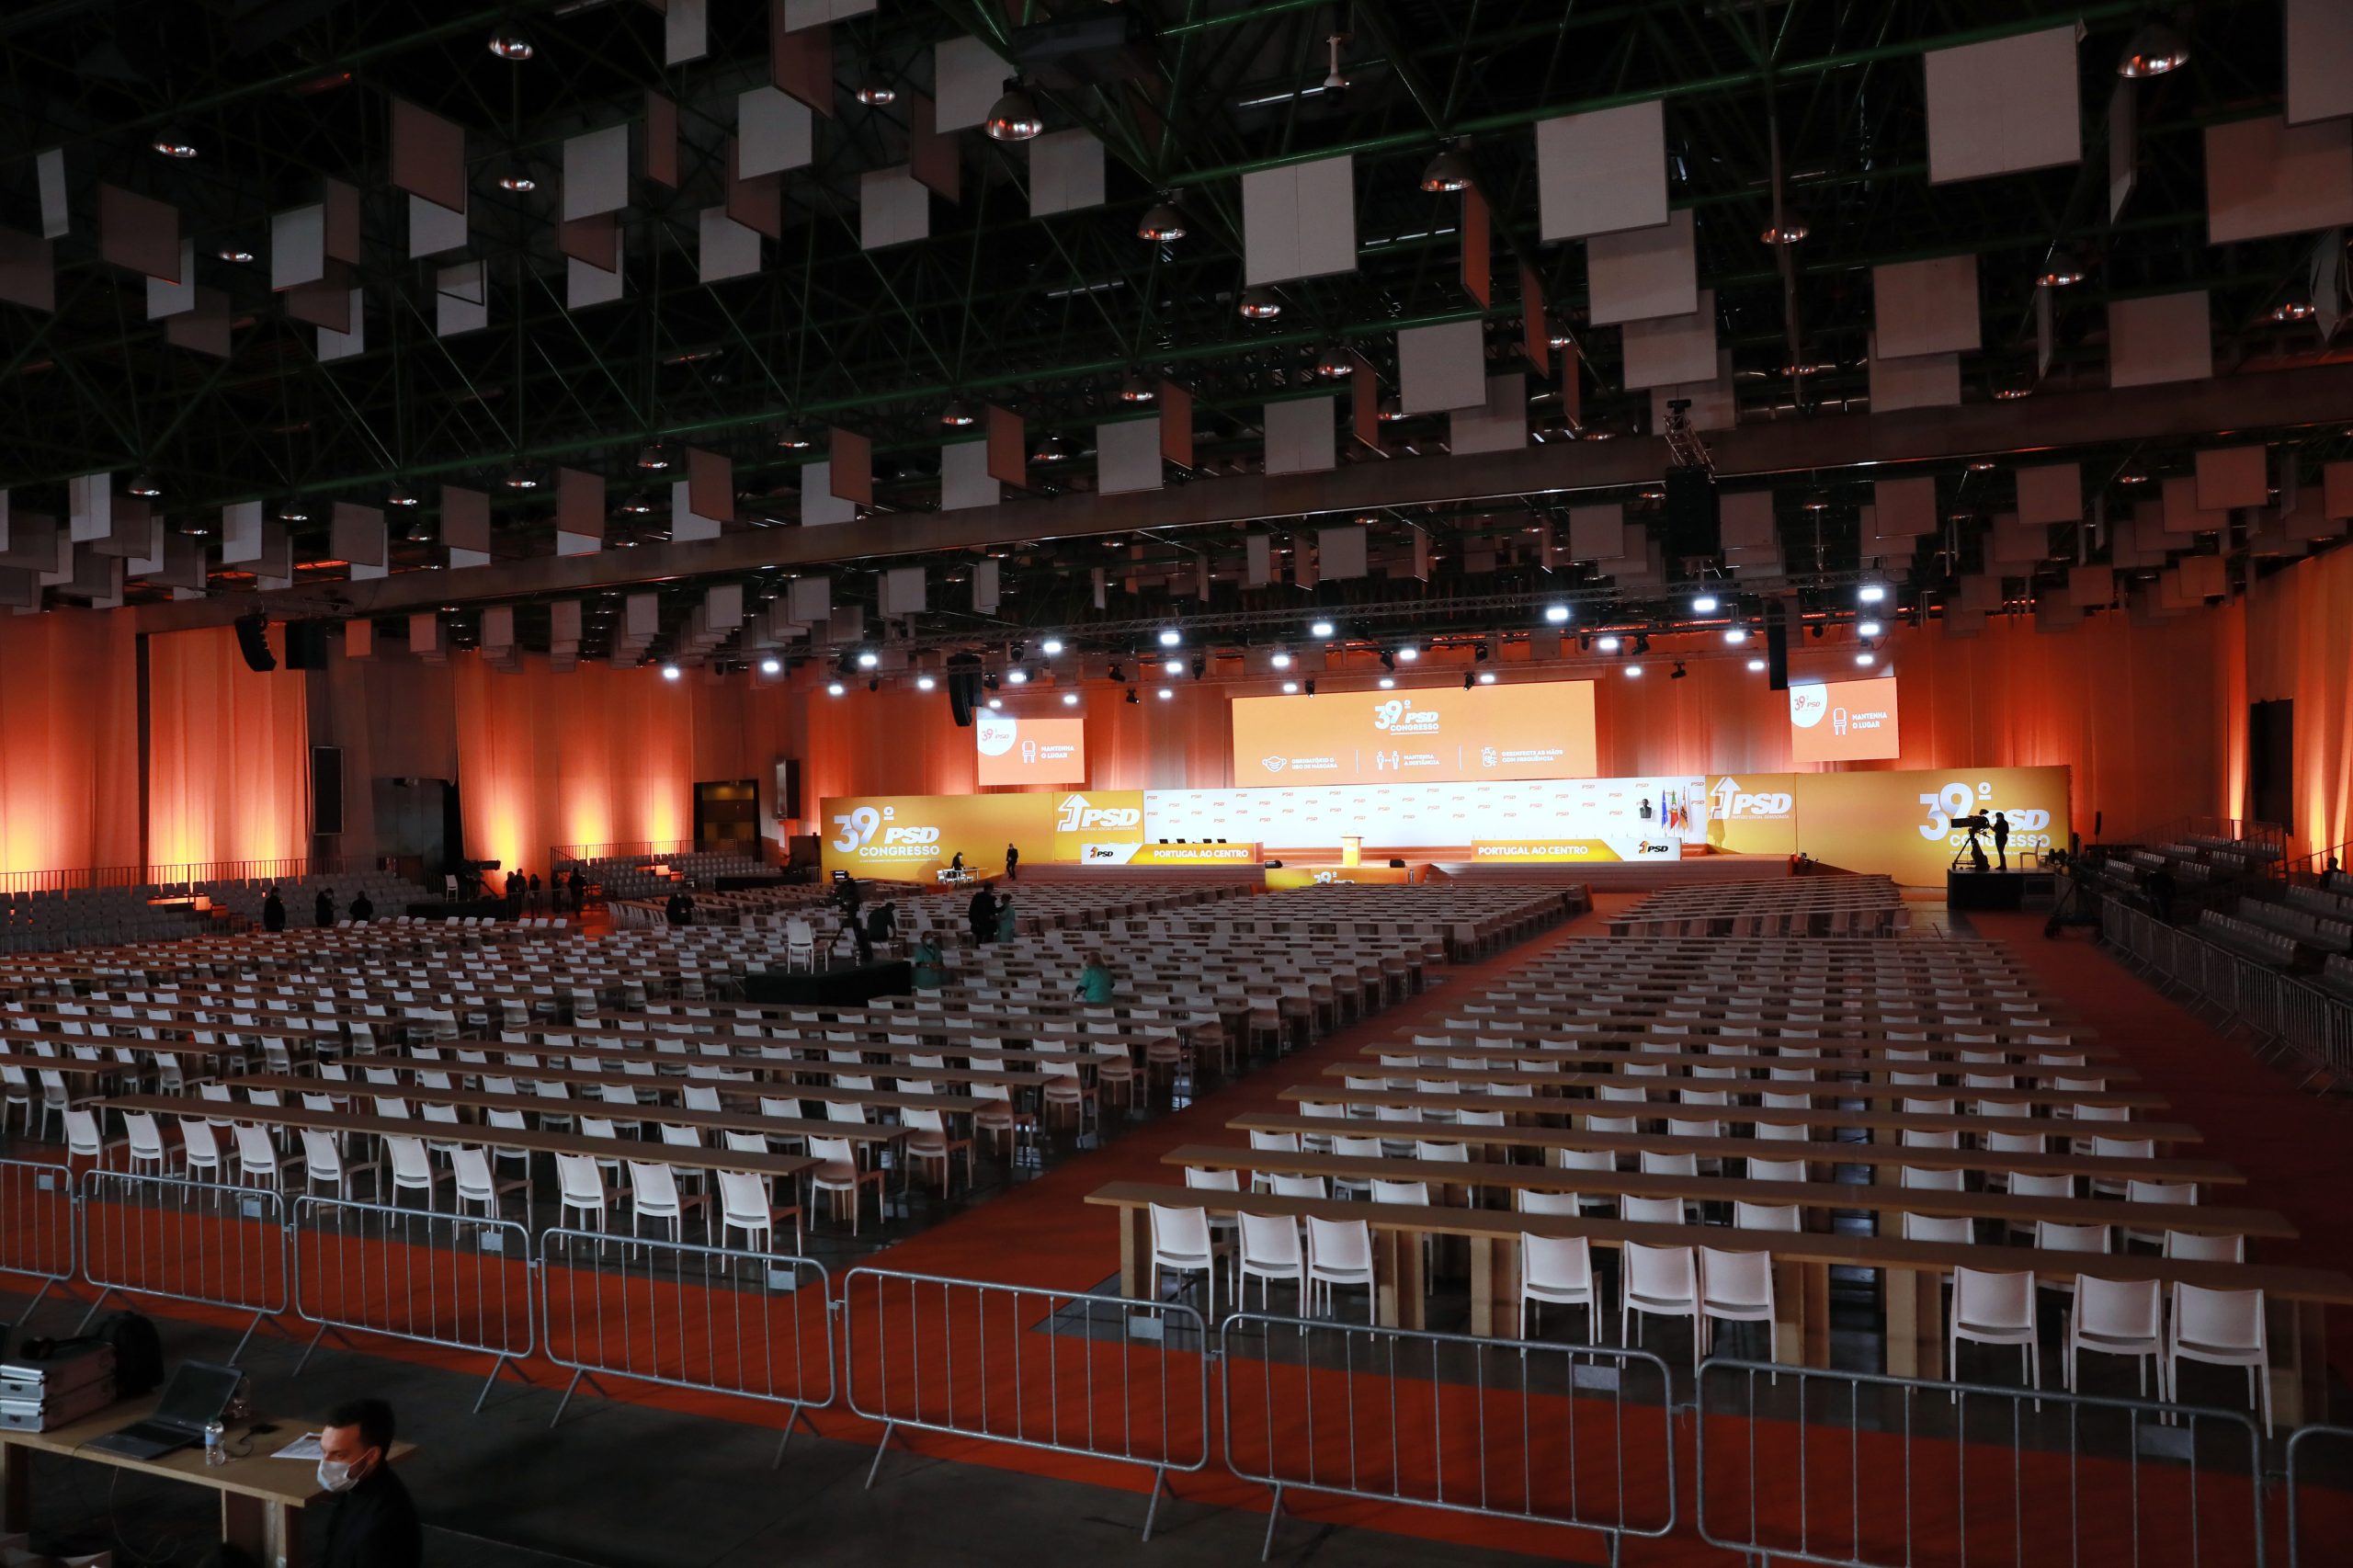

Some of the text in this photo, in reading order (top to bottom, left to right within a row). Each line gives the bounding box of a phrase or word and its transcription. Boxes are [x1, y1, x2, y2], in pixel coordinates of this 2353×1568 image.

[1375, 699, 1411, 730] 39º
[1405, 712, 1439, 723] PSD
[1852, 712, 1887, 721] MANTENHA
[1390, 722, 1439, 732] CONGRESSO
[1733, 793, 1792, 815] PSD
[1081, 808, 1141, 827] PSD
[1918, 781, 1992, 841] 39º
[833, 806, 894, 853] 39º
[884, 827, 940, 844] PSD
[1949, 834, 2051, 847] CONGESSO
[858, 845, 940, 857] CONGRESSO
[1154, 849, 1249, 858] PORTUGAL AO CENTRO
[1478, 846, 1588, 856] PORTUGAL AO CENTRO
